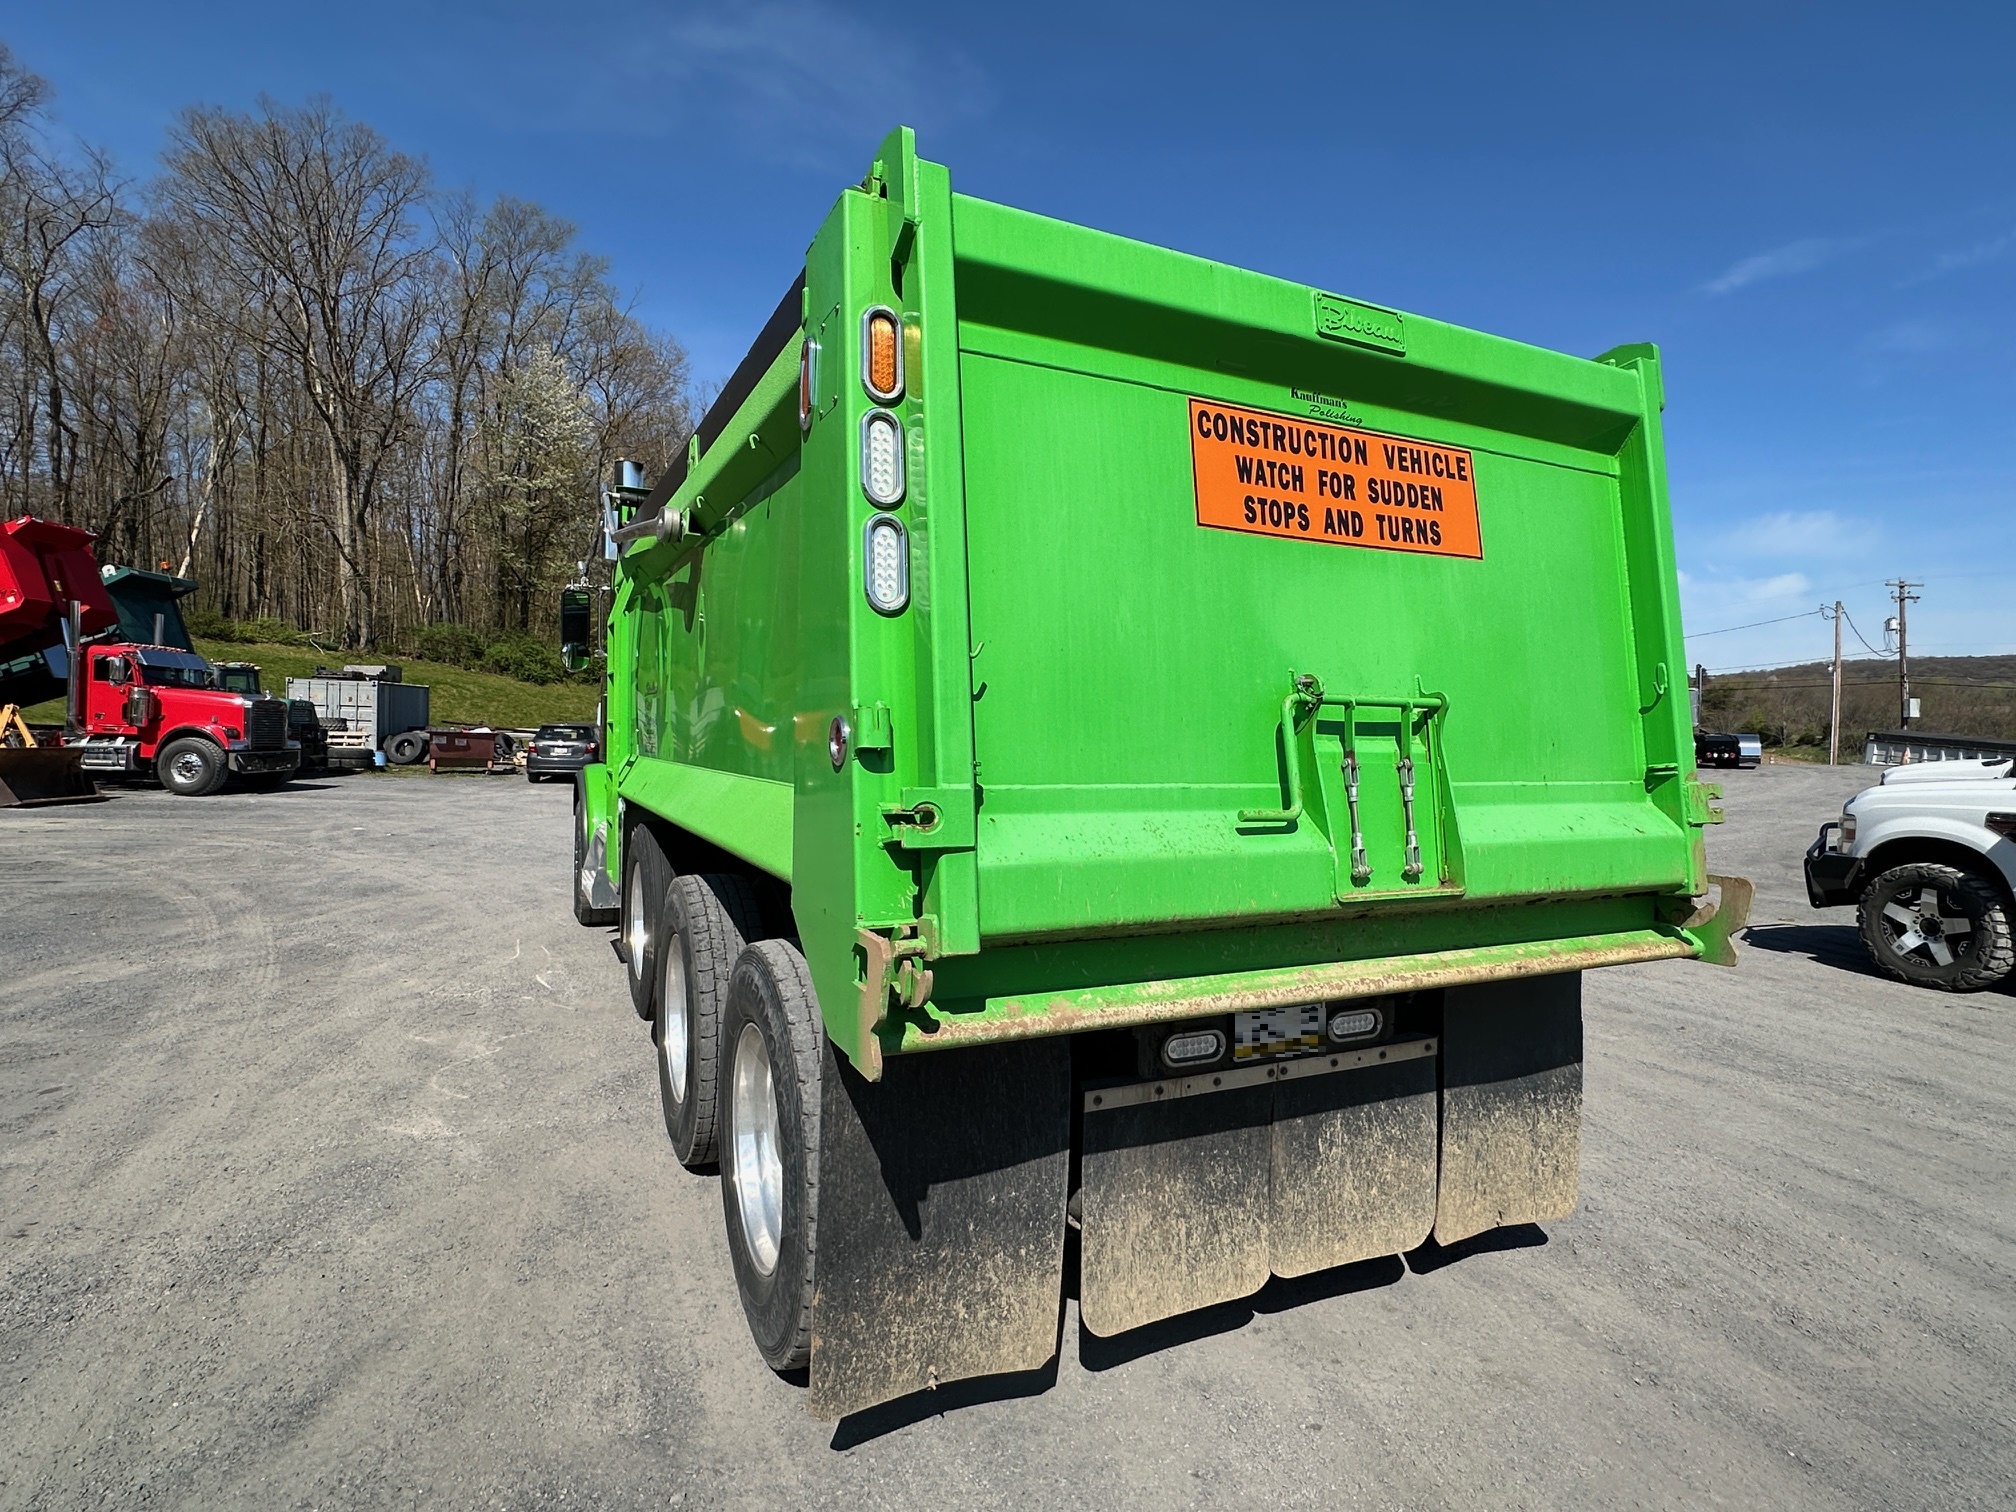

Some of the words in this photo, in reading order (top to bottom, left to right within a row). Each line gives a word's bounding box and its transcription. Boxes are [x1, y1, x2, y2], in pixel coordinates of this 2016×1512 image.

[1290, 386, 1348, 410] Kauffman's
[1309, 404, 1363, 427] Polishing
[1197, 409, 1368, 466] CONSTRUCTION
[1382, 443, 1468, 482] VEHICLE
[1235, 455, 1304, 492] WATCH
[1318, 469, 1356, 501] FOR
[1367, 477, 1444, 512] SUDDEN
[1244, 495, 1310, 532] STOPS
[1324, 507, 1364, 538] AND
[1376, 513, 1442, 547] TURNS
